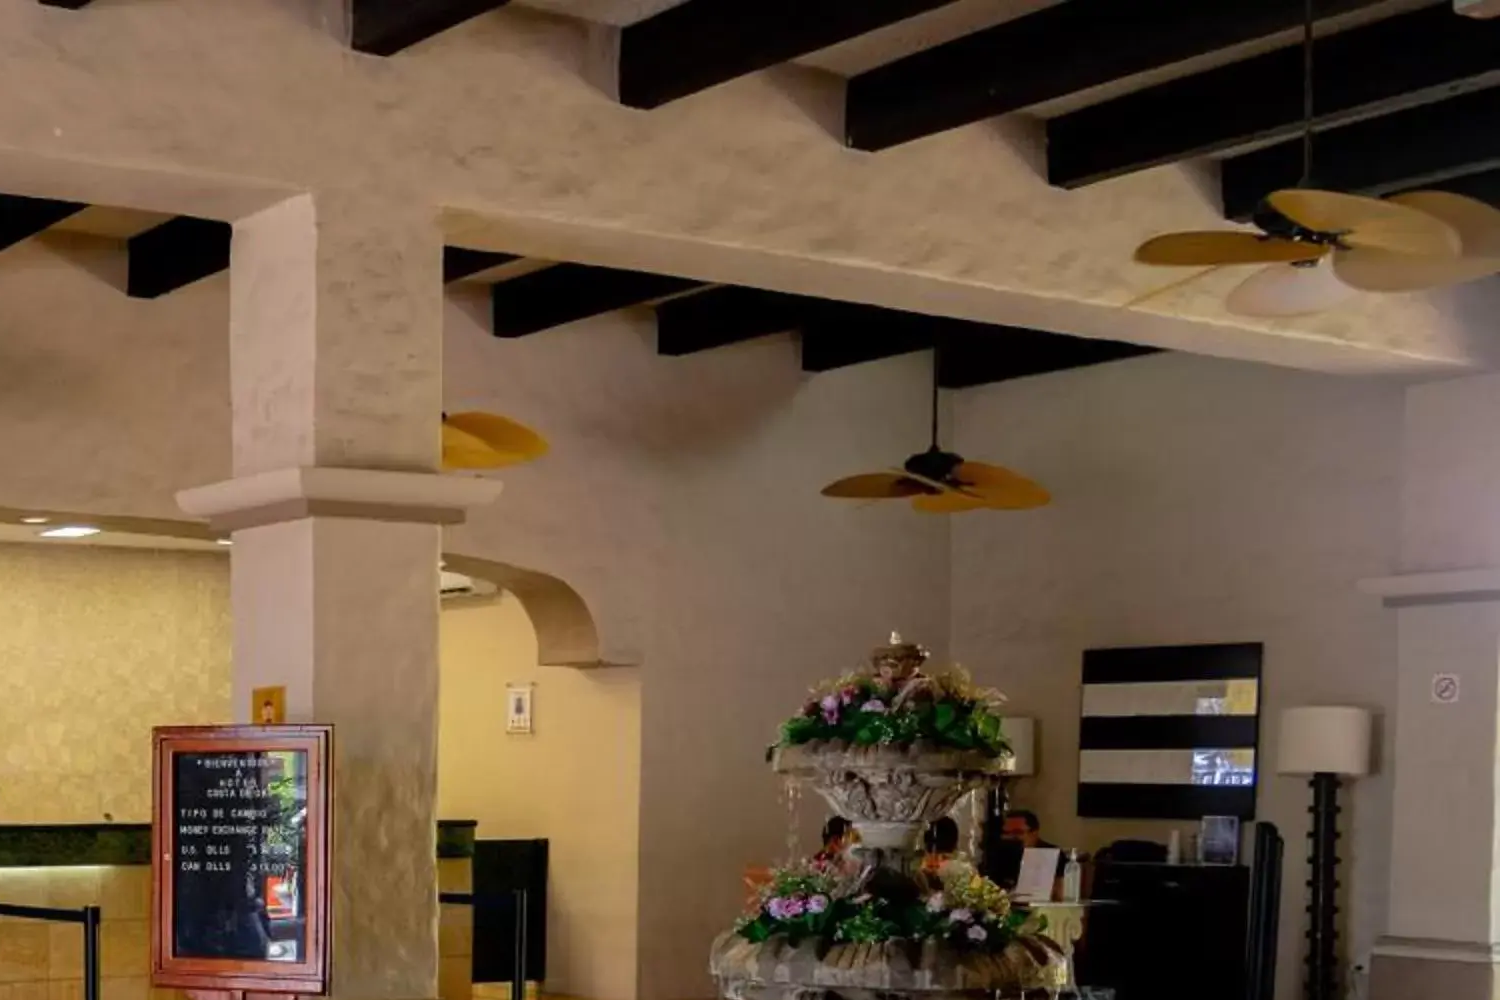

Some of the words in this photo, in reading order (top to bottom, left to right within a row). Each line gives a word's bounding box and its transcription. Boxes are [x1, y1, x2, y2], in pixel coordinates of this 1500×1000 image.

[181, 809, 208, 819] TIPO
[213, 809, 225, 819] DE
[180, 825, 209, 835] MONEY
[212, 825, 257, 836] EXCHANGE
[182, 862, 201, 872] CAN
